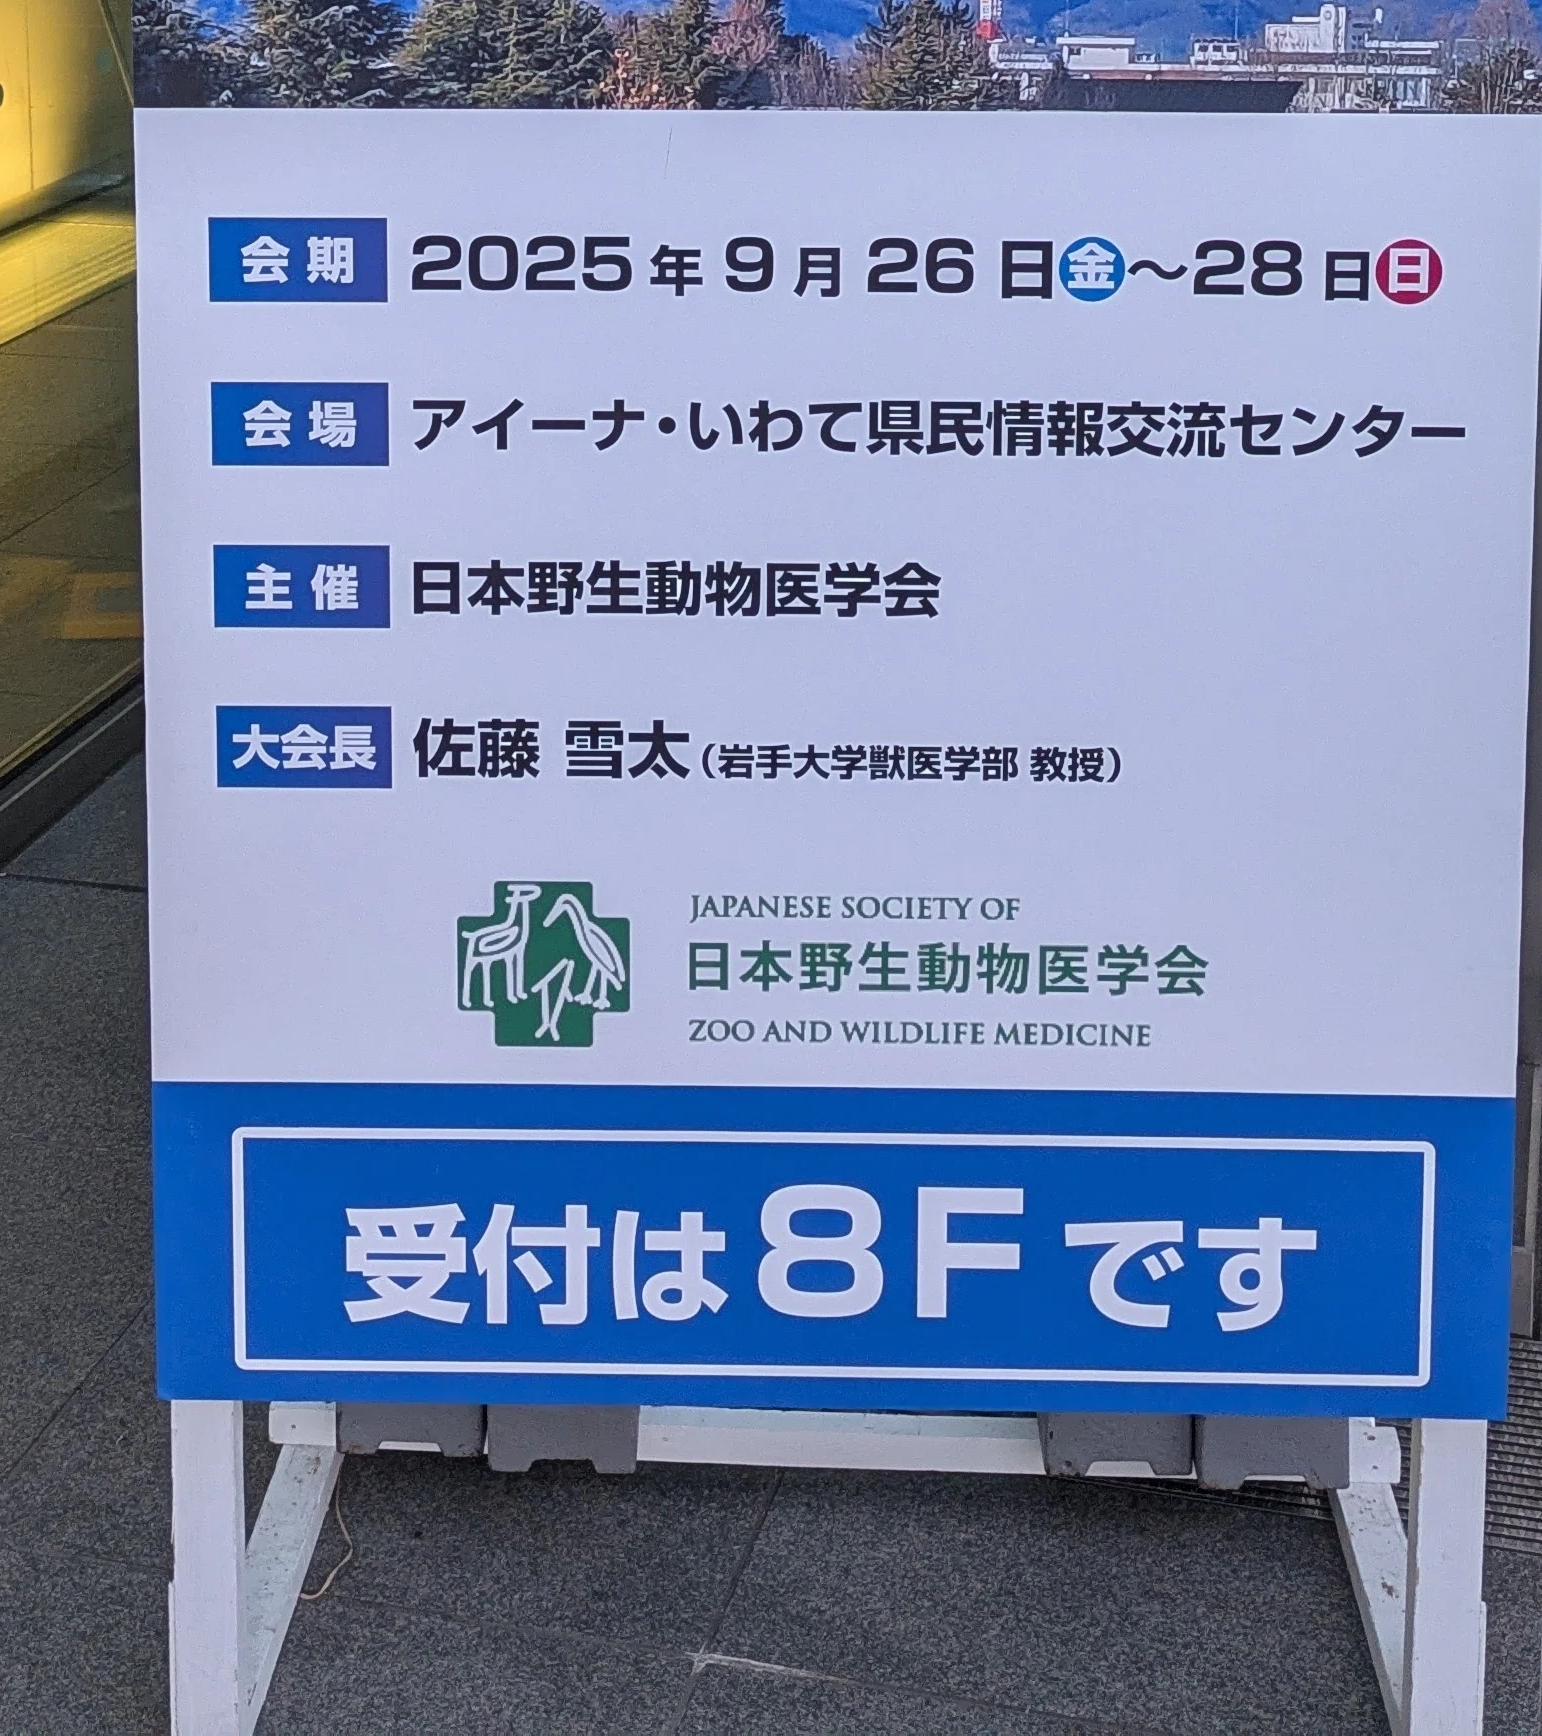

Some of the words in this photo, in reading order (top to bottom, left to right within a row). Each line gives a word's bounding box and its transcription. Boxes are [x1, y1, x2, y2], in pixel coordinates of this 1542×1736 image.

[240, 235, 354, 284] 会期
[242, 399, 357, 448] 会場
[412, 398, 1467, 458] アイーナ・いわて県民情報交流センター
[245, 562, 359, 611] 主催
[413, 559, 942, 619] 日本野生動物医学会
[232, 723, 377, 771] 大会長
[412, 717, 540, 779] 佐藤
[689, 894, 832, 923] JAPANESE
[841, 896, 973, 920] SOCIETY
[981, 897, 1021, 921] OF
[687, 939, 1209, 997] 日本野生動物医学会
[688, 1019, 755, 1042] ZOO
[761, 1020, 832, 1043] AND
[839, 1020, 985, 1045] WILDLIFE
[993, 1022, 1151, 1047] MEDICINE
